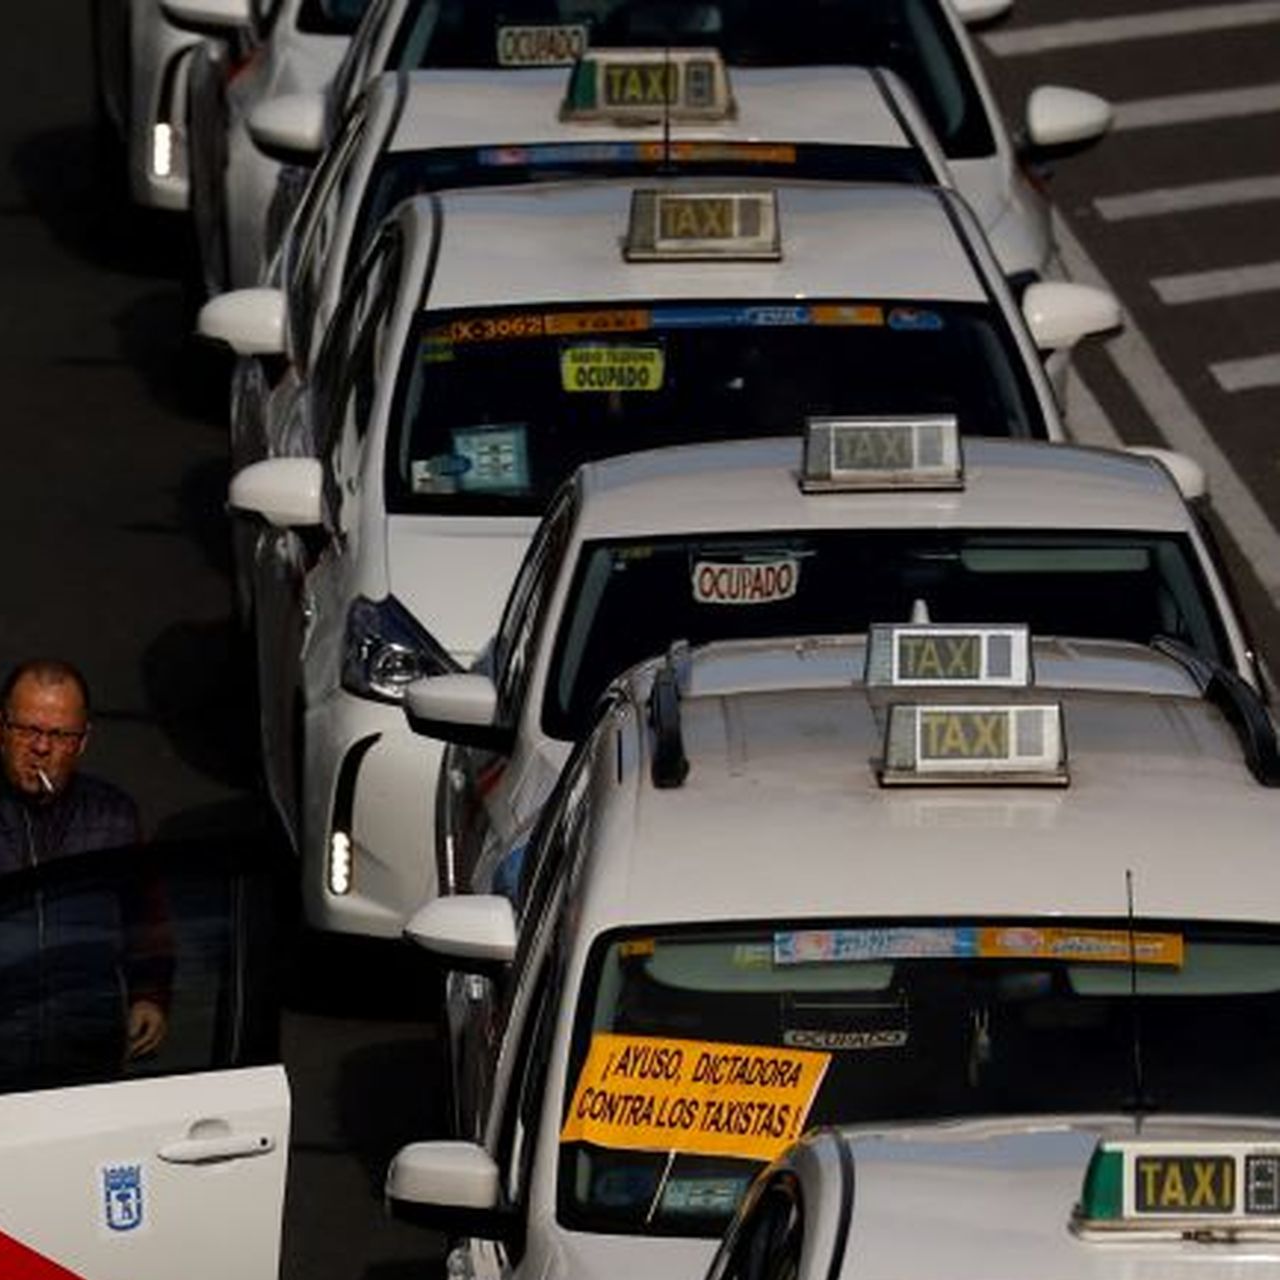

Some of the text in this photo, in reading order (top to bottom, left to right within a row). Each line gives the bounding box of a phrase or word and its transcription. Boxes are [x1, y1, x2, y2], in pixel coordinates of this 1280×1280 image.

[610, 67, 675, 99] TAXI
[665, 205, 728, 234] TAXI
[576, 366, 649, 387] OCUPADO
[842, 430, 910, 463] TAXI
[700, 565, 793, 600] OCUPADO
[904, 639, 979, 674] TAXI
[926, 717, 1007, 755] TAXI
[692, 1053, 802, 1088] DICTADORA
[576, 1087, 654, 1127] CONTRA
[656, 1098, 700, 1130] LOS
[699, 1100, 791, 1139] TAXISTAS
[1140, 1163, 1231, 1206] TAXI
